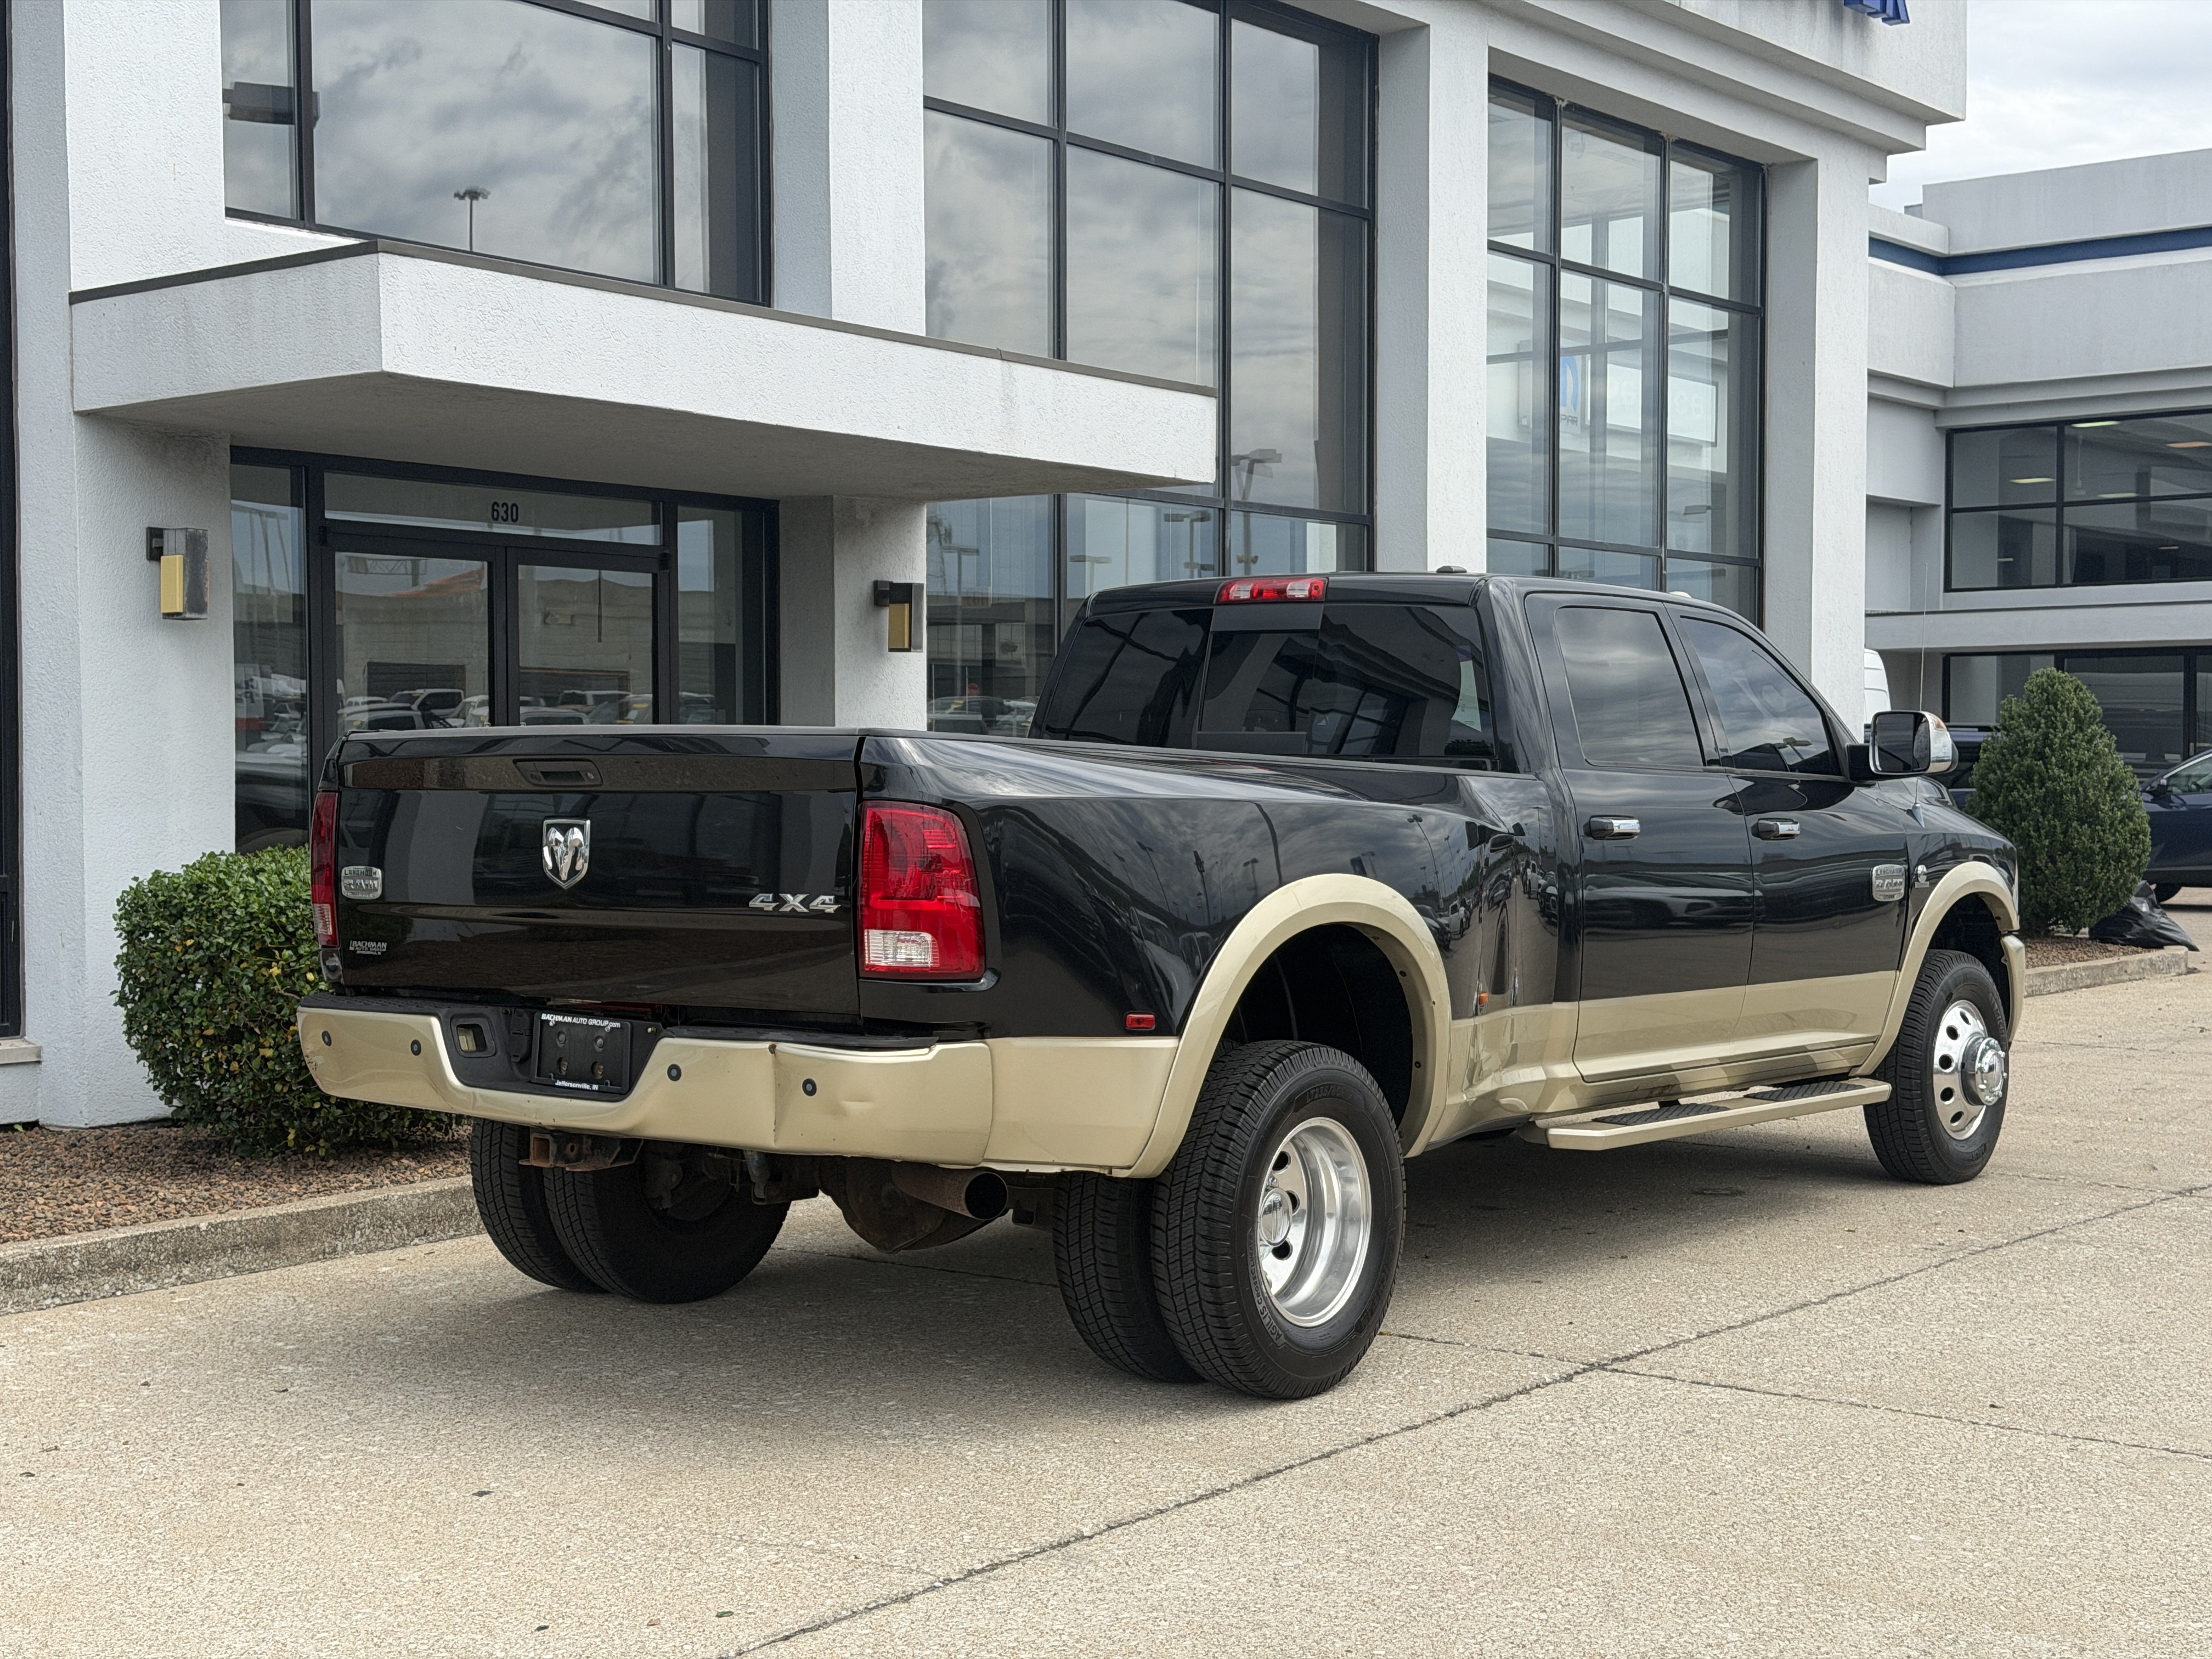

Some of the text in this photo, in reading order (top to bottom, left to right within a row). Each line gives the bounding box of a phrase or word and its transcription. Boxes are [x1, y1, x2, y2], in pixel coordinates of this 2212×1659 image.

[491, 501, 519, 523] 630
[1875, 878, 1903, 890] RAM
[352, 940, 387, 949] BACHMAN
[541, 1013, 572, 1023] BACHMAN
[1259, 1307, 1283, 1341] AGILIS
